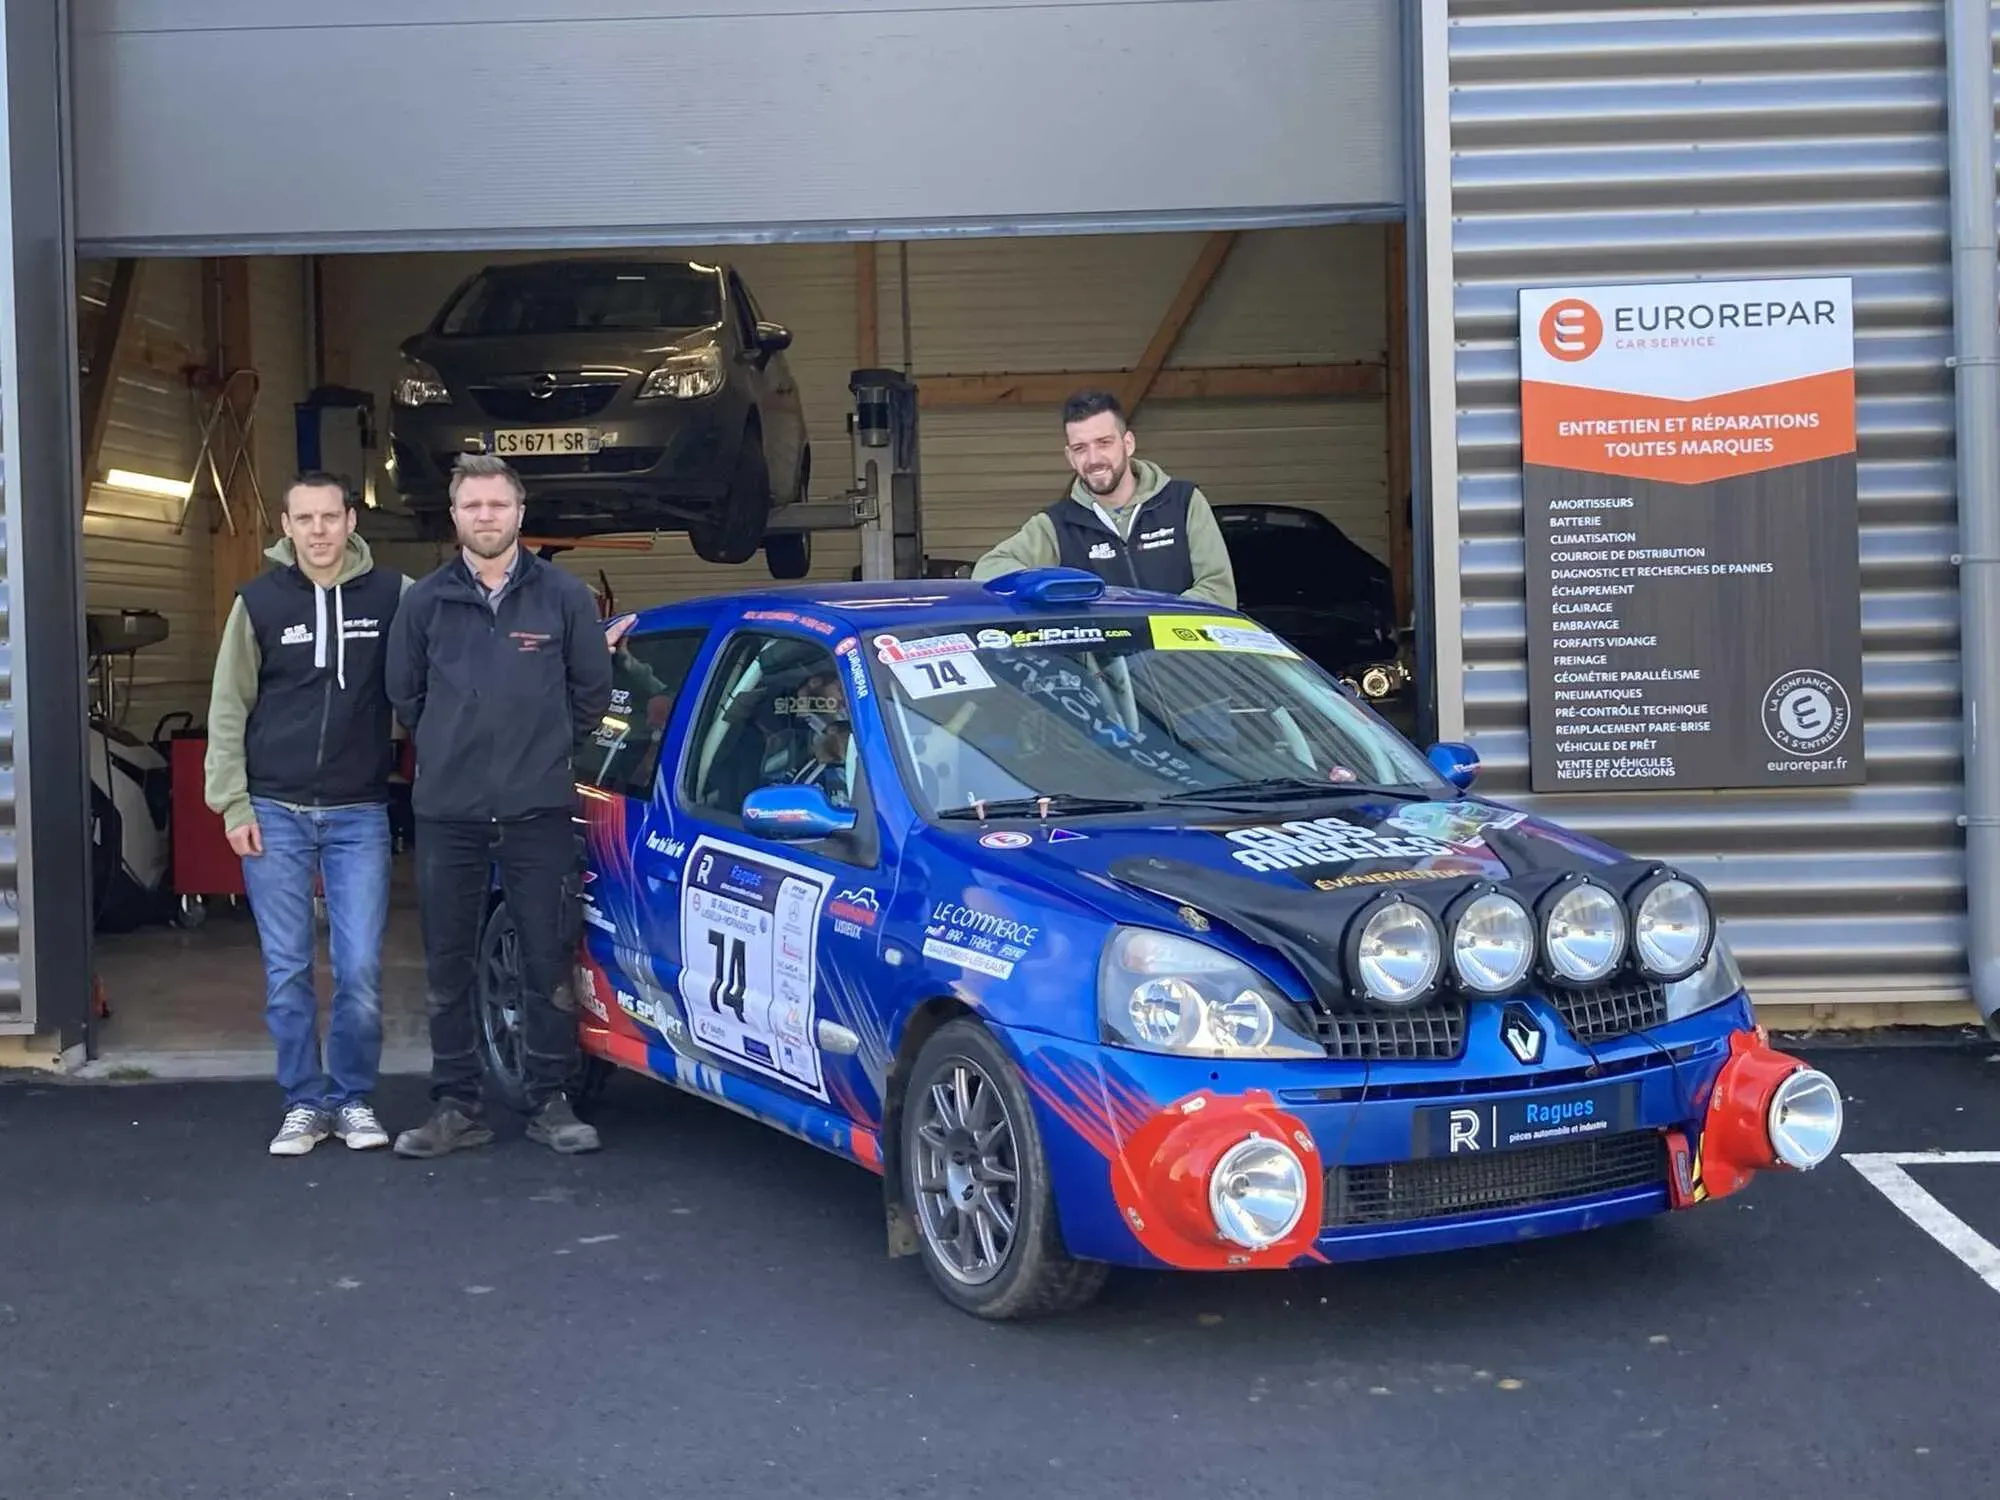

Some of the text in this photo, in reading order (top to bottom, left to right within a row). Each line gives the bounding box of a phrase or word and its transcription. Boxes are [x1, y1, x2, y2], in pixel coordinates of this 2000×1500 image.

[1615, 300, 1836, 332] EUROREPAR
[1616, 335, 1716, 349] CAR SERVICE
[1558, 412, 1820, 437] ENTRETIEN ET RÉPARATIONS
[1605, 437, 1774, 458] TOUTES MARQUES
[1549, 497, 1634, 510] AMORTISSEURS
[1550, 515, 1601, 527] BATTERIE
[1550, 532, 1636, 545] CLIMATISATION
[1550, 547, 1705, 563] COURROIE DE DISTRIBUTION
[1551, 562, 1774, 580] DIAGNOSTIC ET RECHERCHES DE PANNES
[1552, 584, 1635, 597] ÉCHAPPEMENT
[1552, 602, 1613, 614] ÉCLAIRAGE
[1553, 619, 1619, 632] EMBRAYAGE
[1553, 636, 1657, 649] FORFAITS VIDANGE
[1554, 655, 1607, 666] FREINAGE
[847, 648, 869, 700] EUROREPAR
[914, 660, 968, 690] 74
[1554, 668, 1700, 683] GÉOMÉTRIE PARALLÉLISME
[1555, 688, 1643, 701] PNEUMATIQUES
[1770, 676, 1833, 712] LA CONFIANCE
[774, 696, 837, 714] sparco
[1555, 704, 1708, 718] PRÉ-CONTRÔLE TECHNIQUE
[1556, 721, 1711, 735] REMPLACEMENT PARE-BRISE
[1776, 706, 1844, 749] ÇA S'ENTRETIENT
[1556, 738, 1656, 752] VÉHICULE DE PRÊT
[1557, 756, 1673, 770] VENTE DE VÉHICULES
[1767, 757, 1848, 773] eurorepar.fr
[1557, 767, 1675, 779] NEUFS ET OCCASIONS
[1231, 835, 1454, 872] ANGELES
[932, 901, 955, 921] LE
[951, 906, 1039, 946] COMMERCE
[945, 928, 964, 944] BAR
[968, 934, 999, 953] TABAC
[706, 928, 747, 1025] 74
[1527, 1099, 1594, 1124] Ragues
[1508, 1119, 1608, 1144] pièces automobile et industrie
